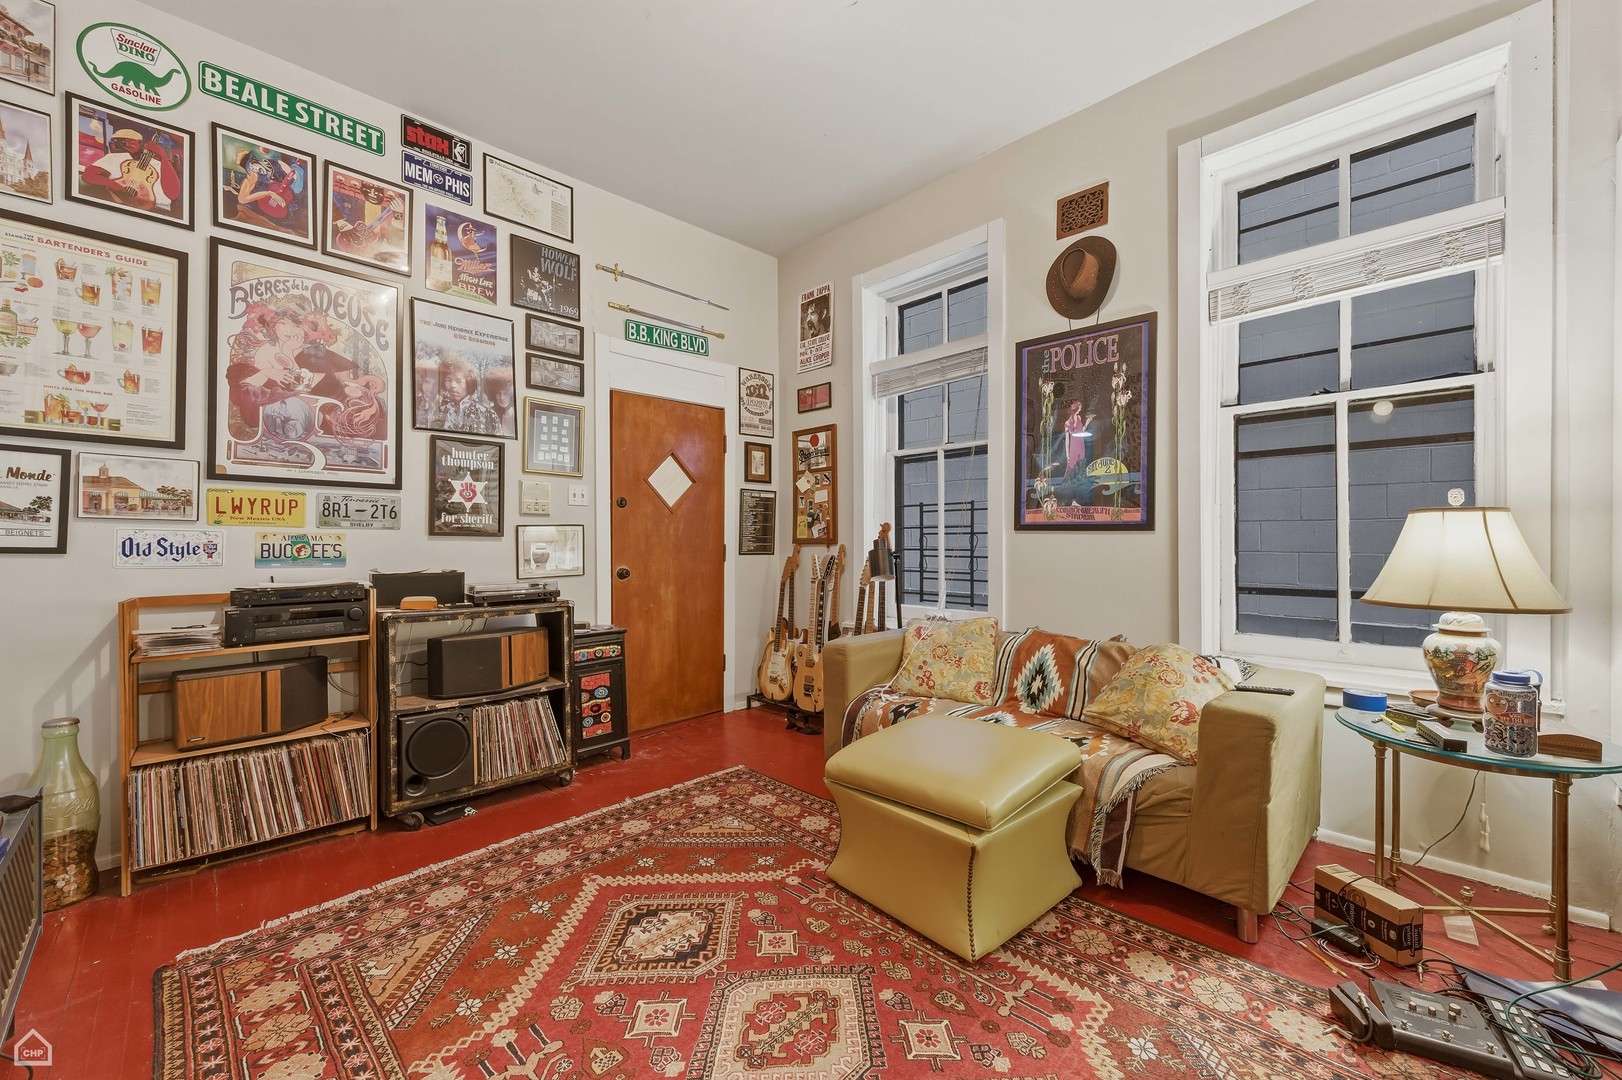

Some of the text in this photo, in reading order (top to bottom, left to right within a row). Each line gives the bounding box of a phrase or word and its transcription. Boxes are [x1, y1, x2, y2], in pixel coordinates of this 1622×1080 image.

[116, 33, 158, 54] Sinclair
[118, 42, 155, 62] DINO
[110, 83, 162, 106] GASOLINE
[203, 67, 382, 151] BEALE STREET
[406, 125, 449, 156] stax
[37, 236, 111, 259] BARTENDER'S
[115, 254, 149, 267] GUIDE
[454, 257, 496, 275] Miller
[540, 257, 577, 282] WOLF
[458, 282, 494, 298] BREW
[801, 291, 815, 303] FRANK
[310, 282, 389, 351] MEUSE
[560, 304, 579, 316] 1969
[629, 322, 706, 353] B.B. KING BLVD
[1042, 349, 1050, 373] the
[1050, 334, 1119, 373] POLICE
[441, 454, 494, 470] thompson
[452, 447, 489, 461] hunter
[6, 466, 53, 482] Monde
[215, 495, 299, 516] LWYRUP
[1056, 506, 1110, 516] COMMONWEALTH
[441, 512, 494, 525] for sheriff
[5, 529, 45, 537] BEIGNETS
[121, 537, 201, 562] Old Style
